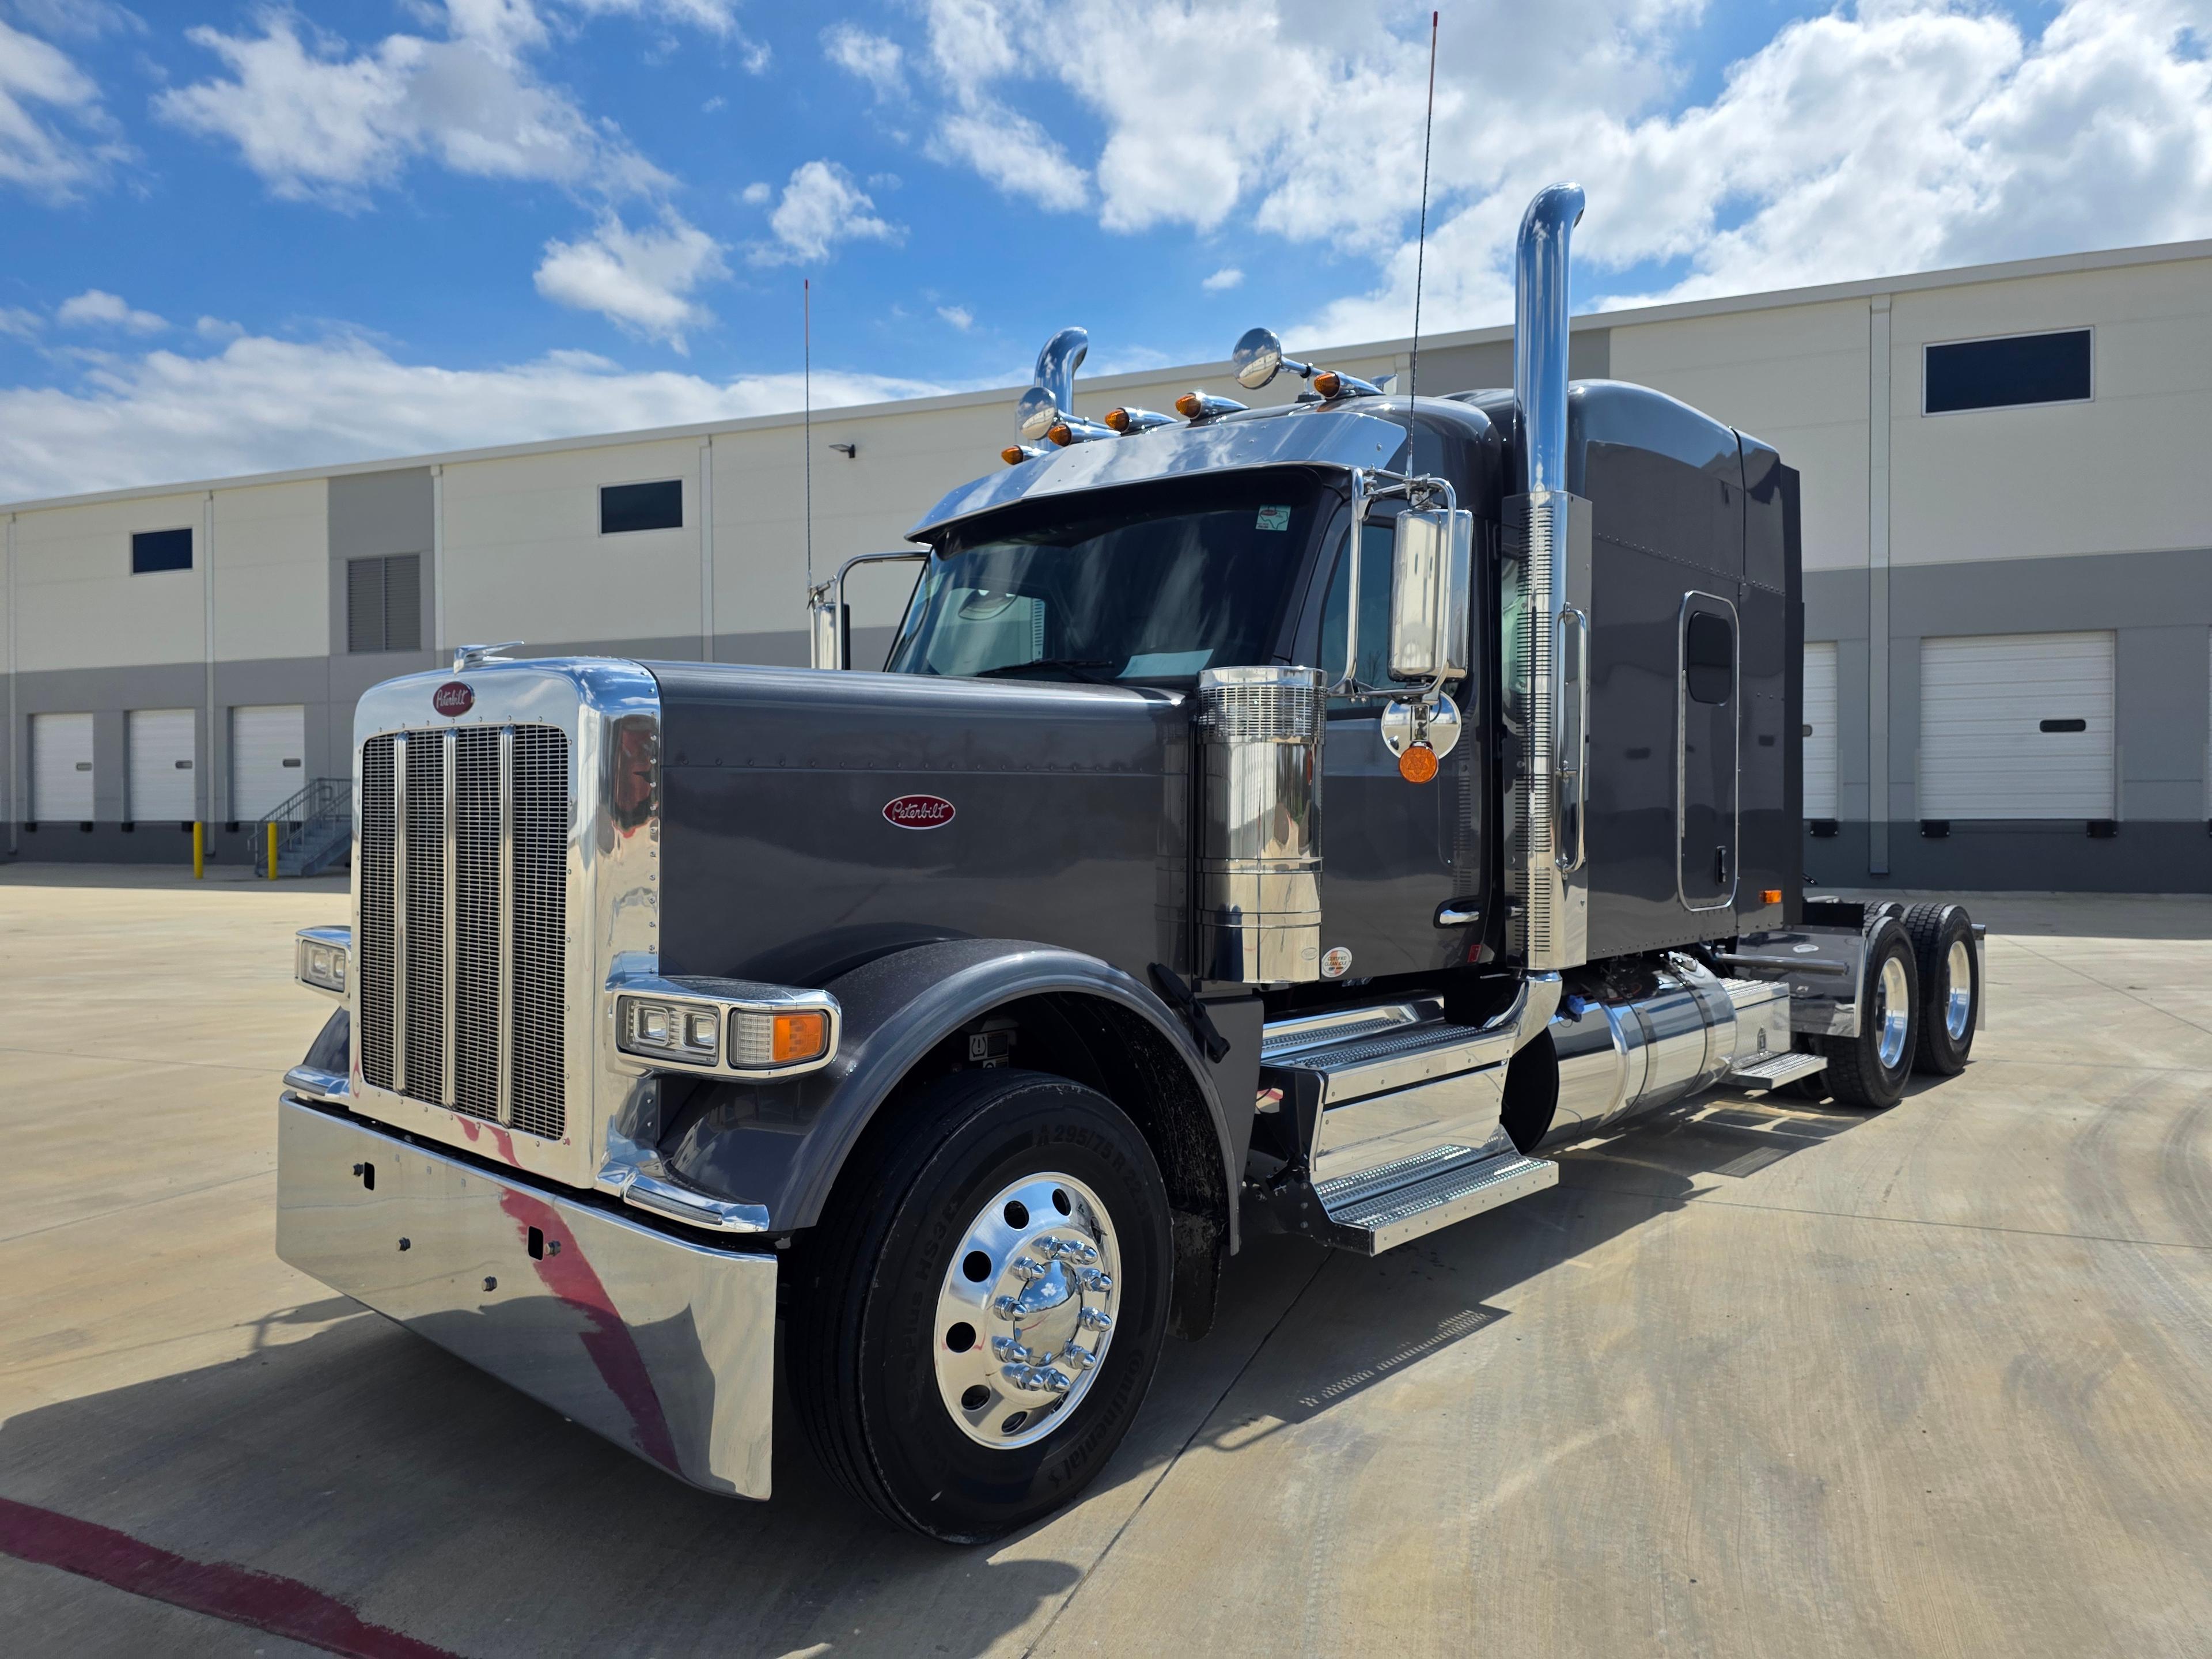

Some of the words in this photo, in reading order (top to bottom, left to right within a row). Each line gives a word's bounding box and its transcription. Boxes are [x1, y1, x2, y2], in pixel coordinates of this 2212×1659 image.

[436, 689, 468, 709] Peterbilt
[892, 801, 949, 820] Peterbilt
[1054, 1124, 1114, 1159] 295/75
[1112, 1152, 1126, 1173] R
[1063, 1349, 1144, 1480] Continental
